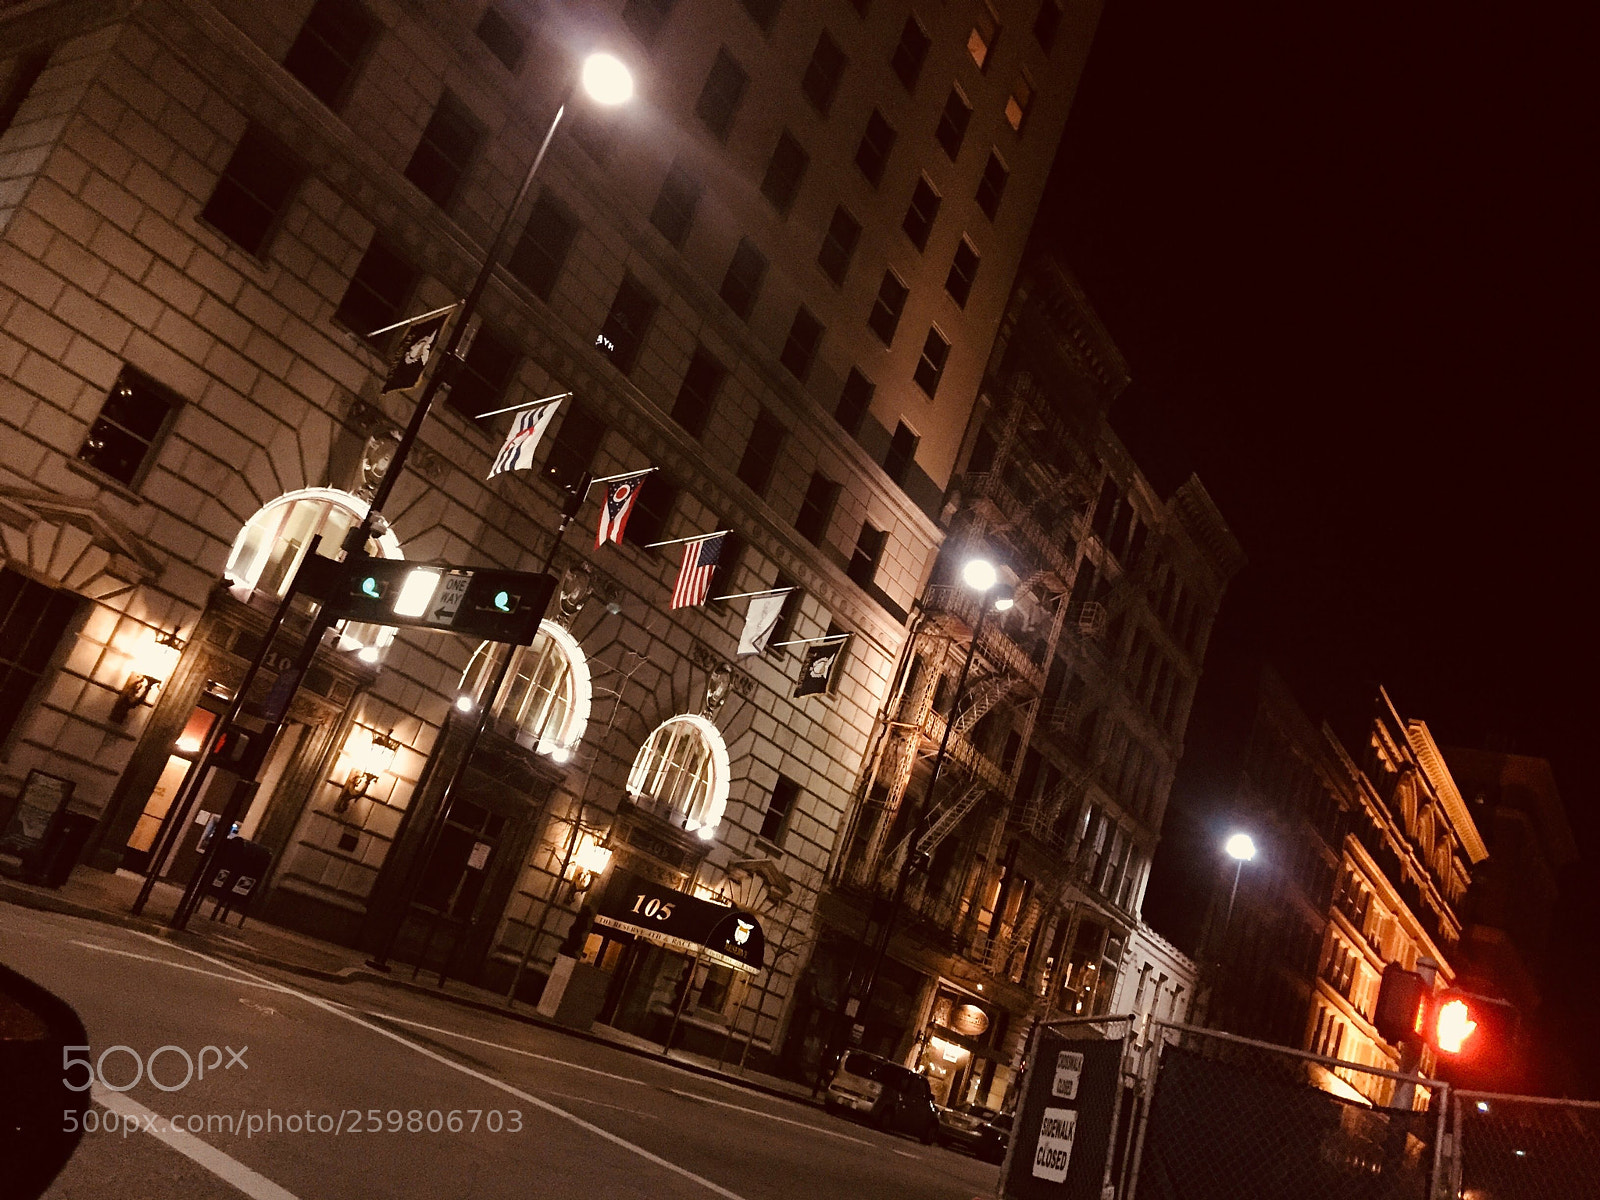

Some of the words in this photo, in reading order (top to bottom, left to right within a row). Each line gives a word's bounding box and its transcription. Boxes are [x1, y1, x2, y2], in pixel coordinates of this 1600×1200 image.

[446, 579, 467, 591] ONE
[440, 592, 462, 604] WAY
[630, 894, 676, 920] 105
[1041, 1117, 1075, 1141] SIDEWALK
[1036, 1146, 1068, 1170] CLOSED
